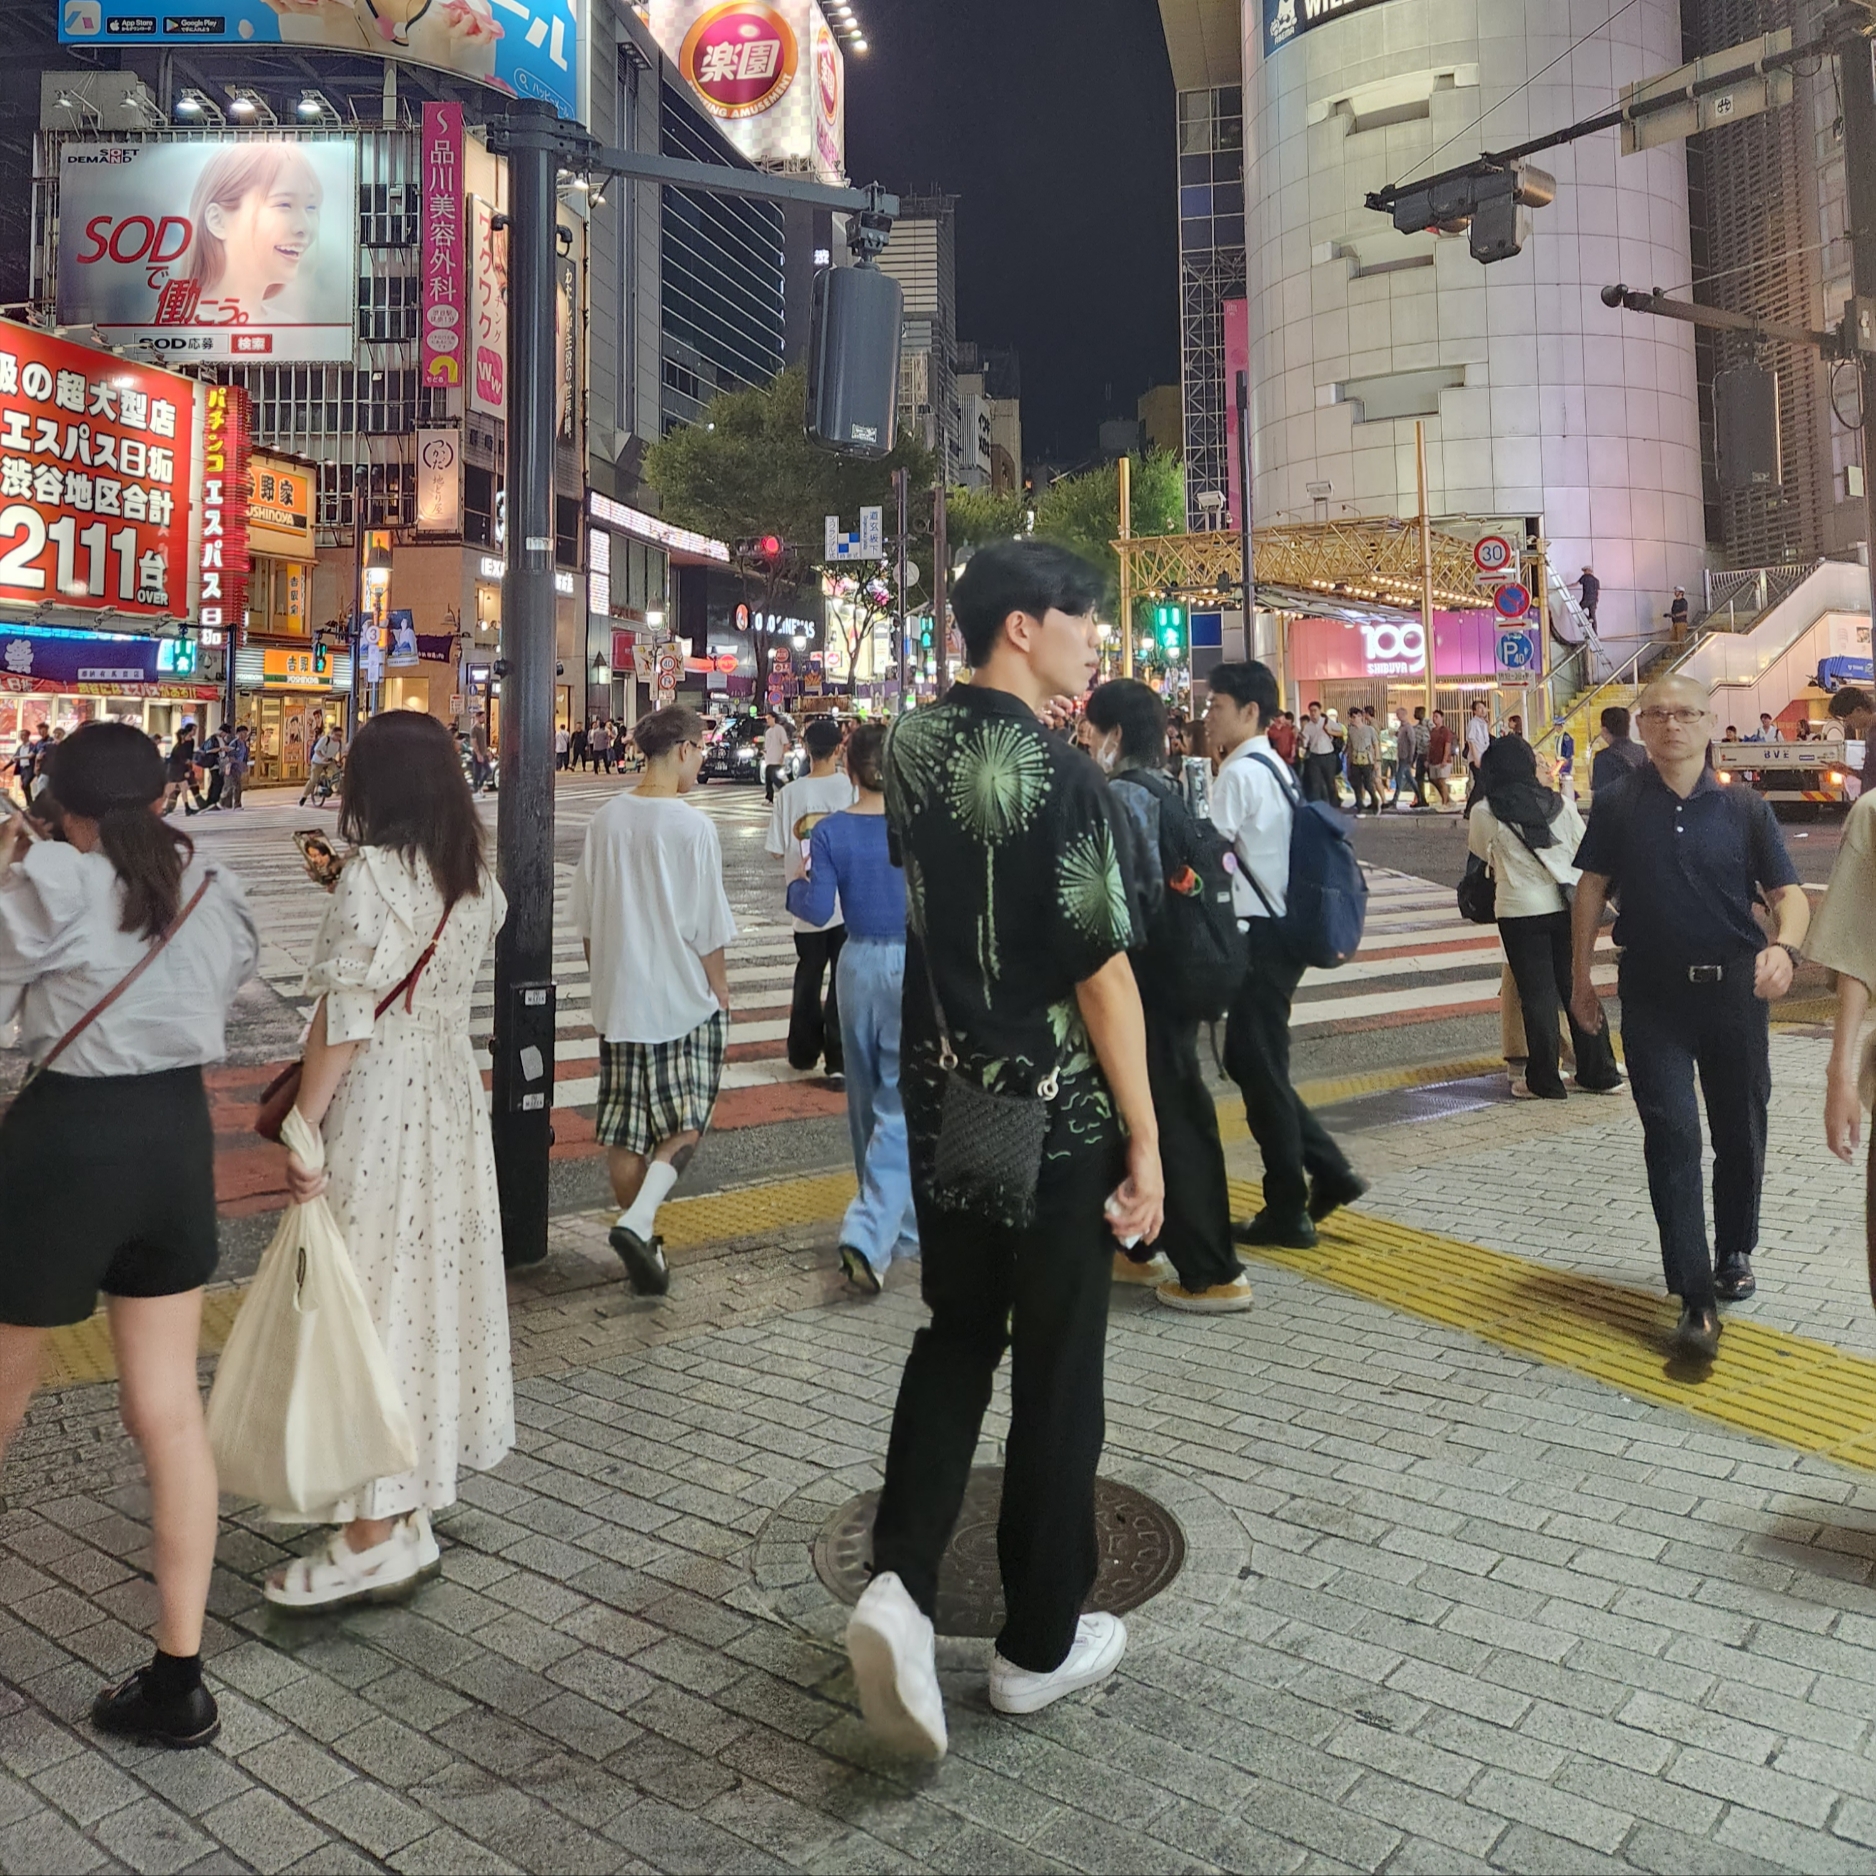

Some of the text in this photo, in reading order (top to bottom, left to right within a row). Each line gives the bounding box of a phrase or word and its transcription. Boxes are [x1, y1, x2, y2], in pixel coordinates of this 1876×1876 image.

[121, 20, 135, 30] App
[181, 19, 217, 28] Google Play
[698, 39, 781, 83] 楽園
[730, 73, 793, 119] AMUSEMENT
[67, 156, 133, 164] DEMAND
[99, 148, 140, 157] SOFT
[429, 139, 457, 303] 品川美容外科
[76, 215, 193, 264] SOD
[145, 265, 170, 290] で
[154, 278, 250, 326] 働こう。
[237, 336, 266, 351] 検索
[206, 387, 227, 473] パチンコ
[0, 408, 175, 485] エスパス日拓
[0, 455, 175, 527] 渋谷地区合計
[869, 511, 879, 555] 道玄坂下
[1482, 545, 1503, 562] 30
[137, 589, 169, 606] OVER
[369, 628, 378, 641] 3
[1360, 622, 1426, 674] 109
[1503, 641, 1518, 665] P
[1513, 653, 1525, 664] 40
[662, 659, 673, 668] 40
[1366, 661, 1408, 675] SHIBUYA
